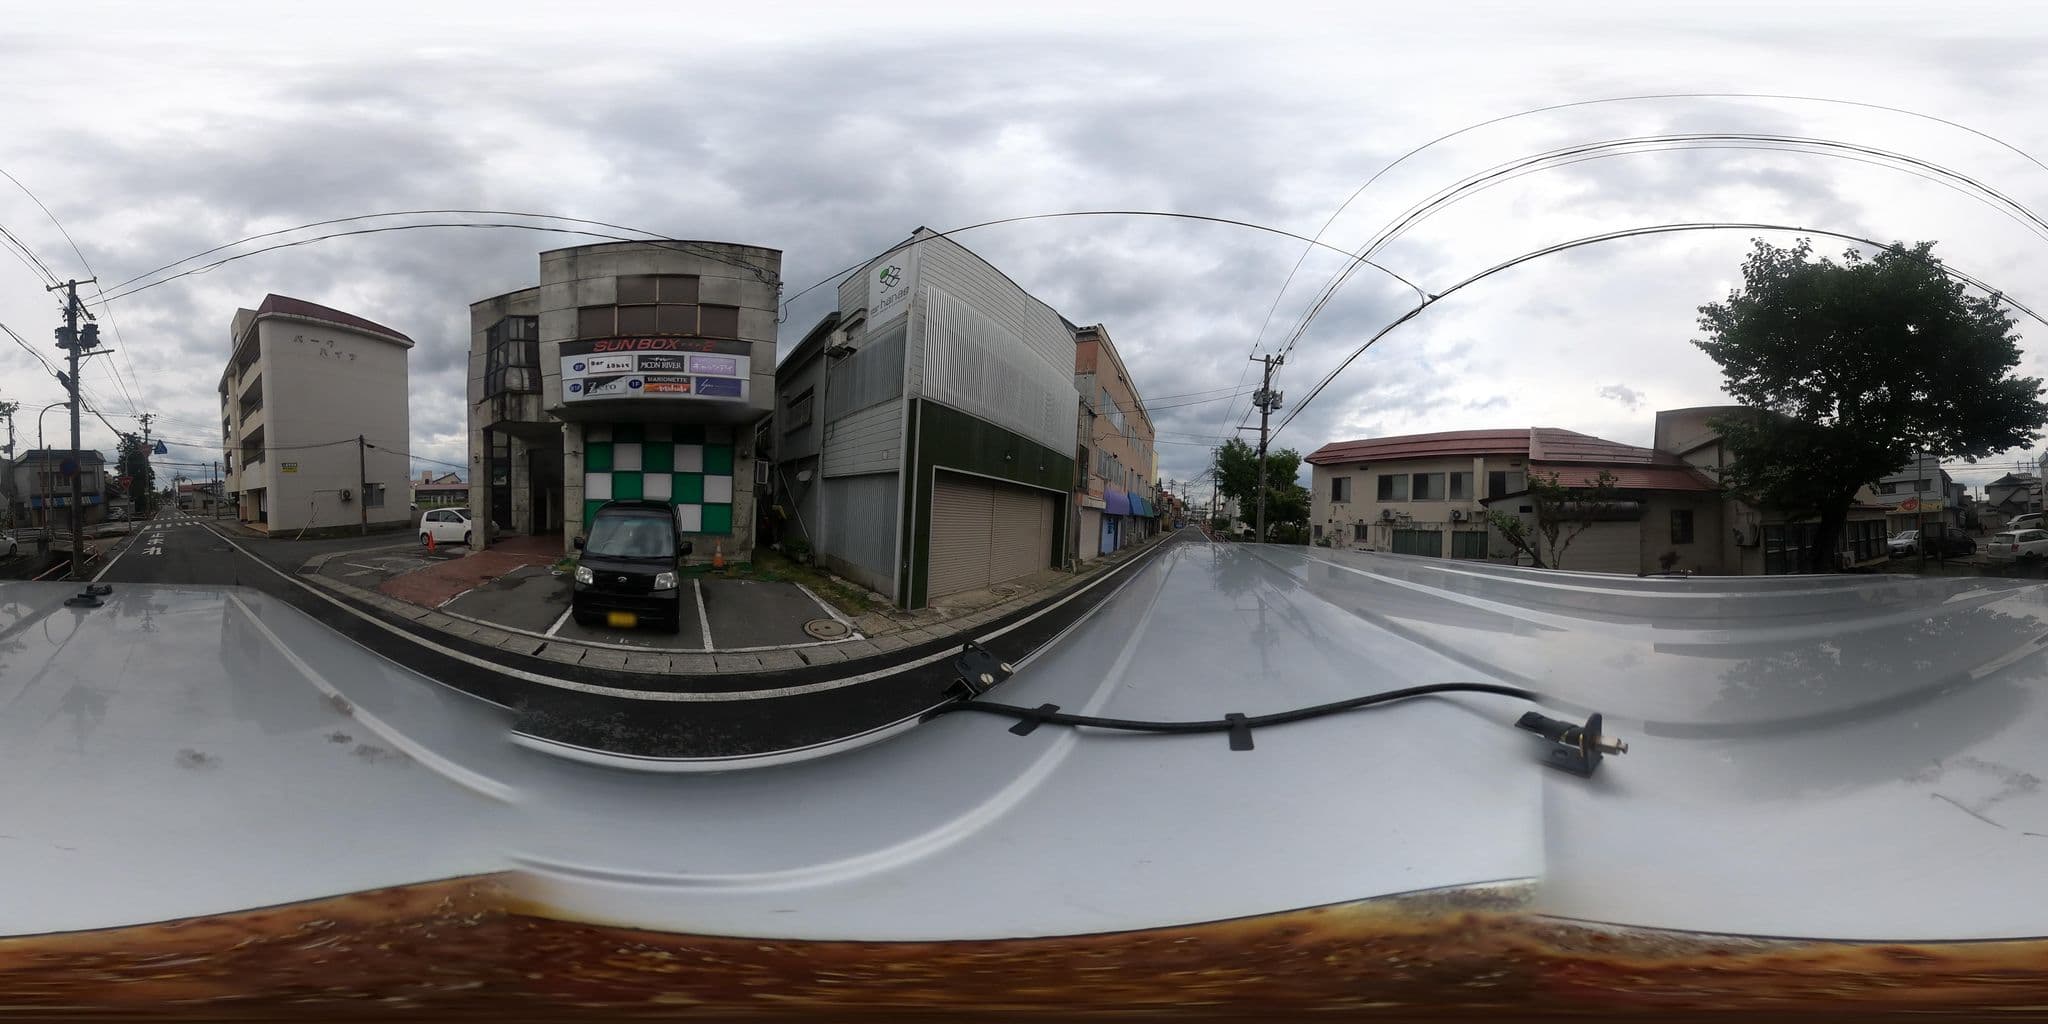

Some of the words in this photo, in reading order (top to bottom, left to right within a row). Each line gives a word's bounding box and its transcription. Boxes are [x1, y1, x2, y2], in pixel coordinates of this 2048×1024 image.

[593, 339, 635, 352] SUN
[637, 338, 681, 350] BOX
[640, 361, 660, 369] MOON
[661, 361, 682, 369] RIVER
[142, 532, 164, 555] 止まれ
